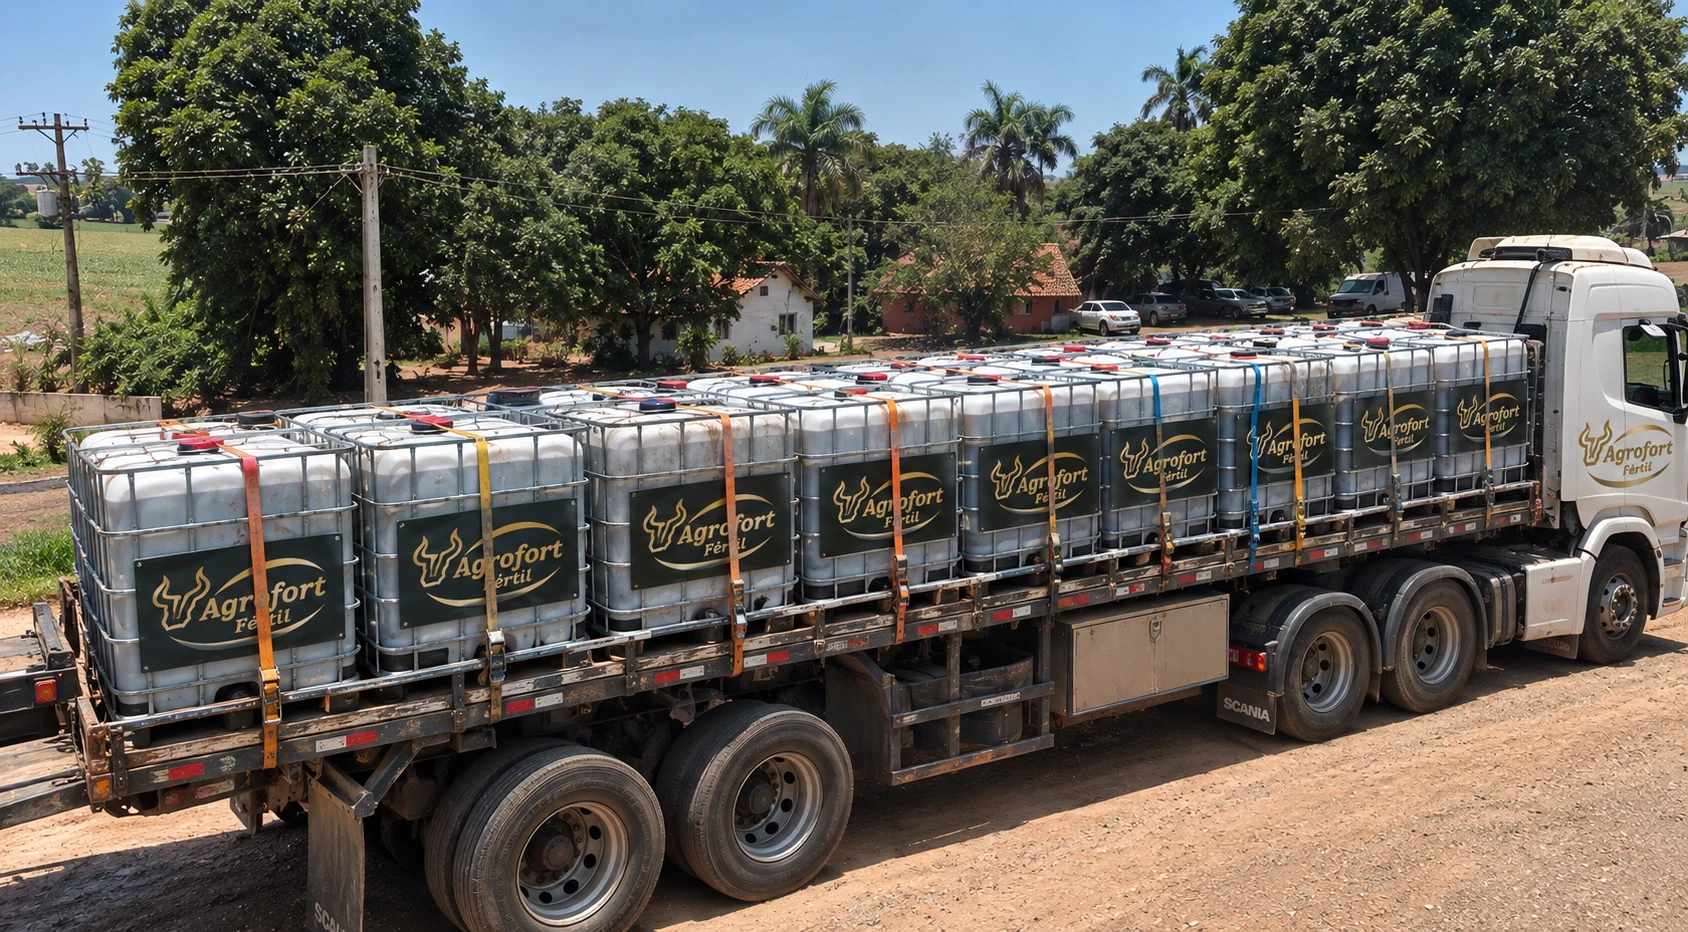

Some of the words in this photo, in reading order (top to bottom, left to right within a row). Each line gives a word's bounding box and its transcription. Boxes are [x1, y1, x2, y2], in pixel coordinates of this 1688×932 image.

[1142, 448, 1207, 475] Agrofort
[1282, 450, 1309, 464] Féil
[1602, 440, 1674, 466] Agrofort
[1622, 461, 1653, 476] Fértil
[1034, 489, 1067, 504] Fétil
[884, 511, 920, 528] Ftil
[703, 537, 747, 557] Féril
[482, 568, 533, 591] értil
[234, 608, 292, 634] Fétil
[1223, 697, 1270, 722] SCANIA
[314, 902, 346, 932] SCA
